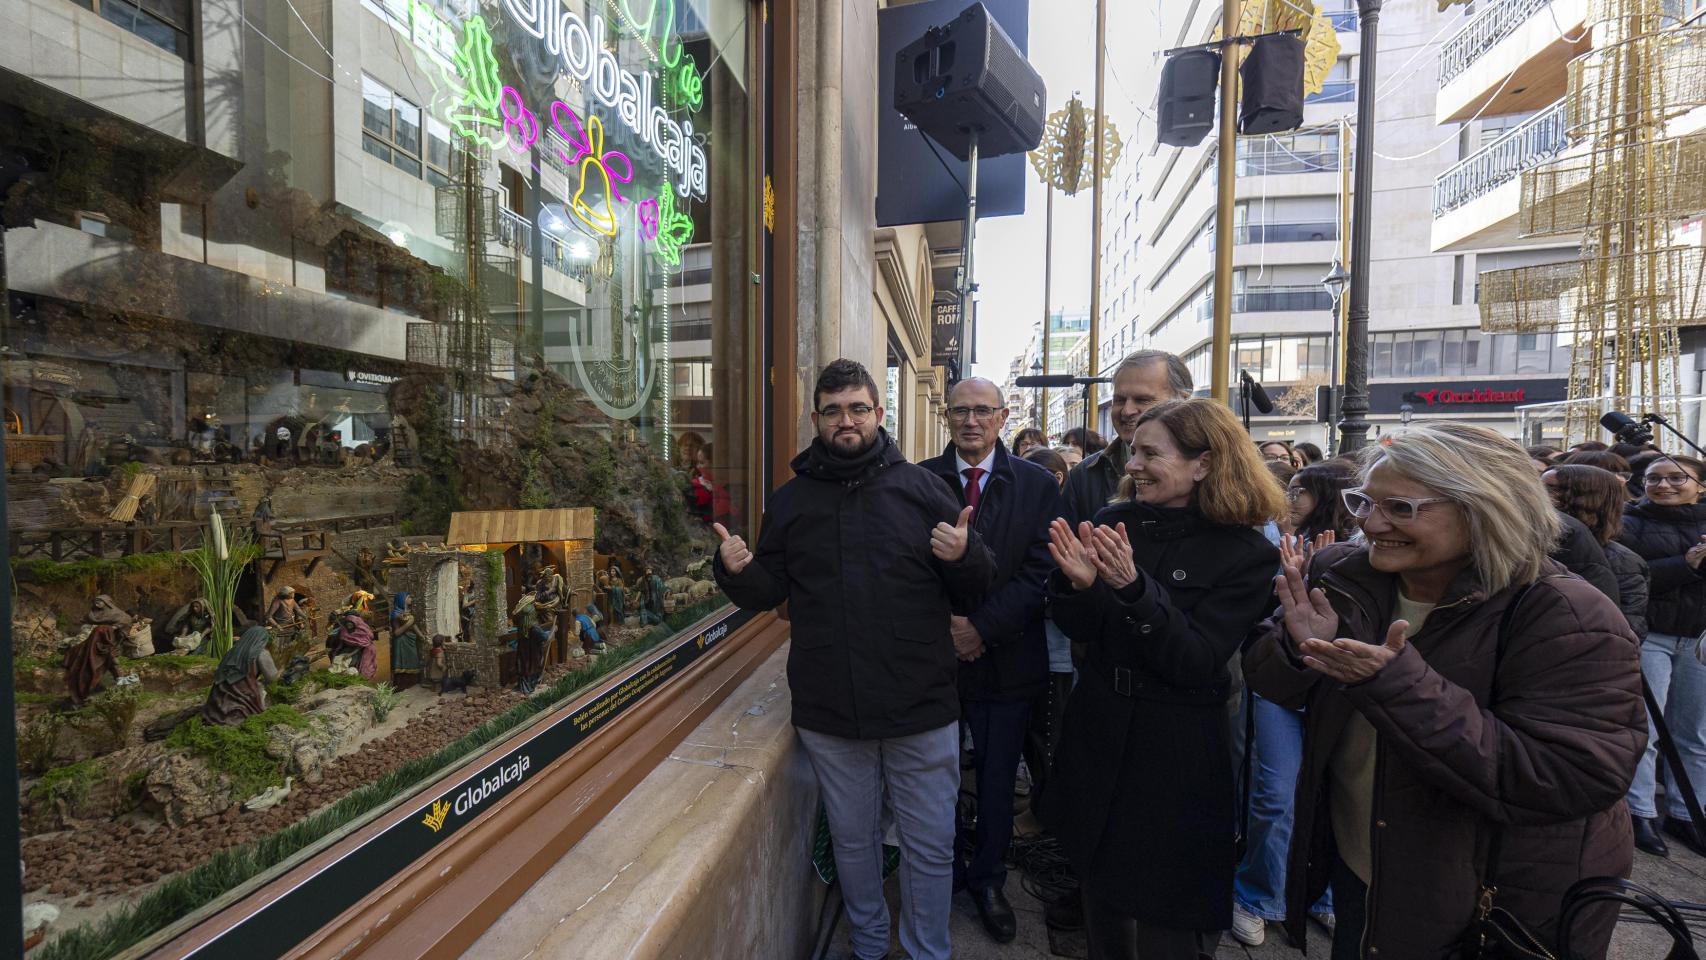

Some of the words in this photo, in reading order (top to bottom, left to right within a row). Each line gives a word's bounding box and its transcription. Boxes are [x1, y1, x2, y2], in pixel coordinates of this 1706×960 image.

[937, 314, 960, 325] ROM
[1439, 387, 1526, 403] Occident
[704, 623, 728, 645] Globalcaja
[573, 711, 589, 726] Belén
[611, 692, 619, 704] por
[580, 723, 589, 732] las
[589, 708, 610, 728] personas
[610, 700, 618, 711] del
[454, 755, 530, 816] Globalcaja
